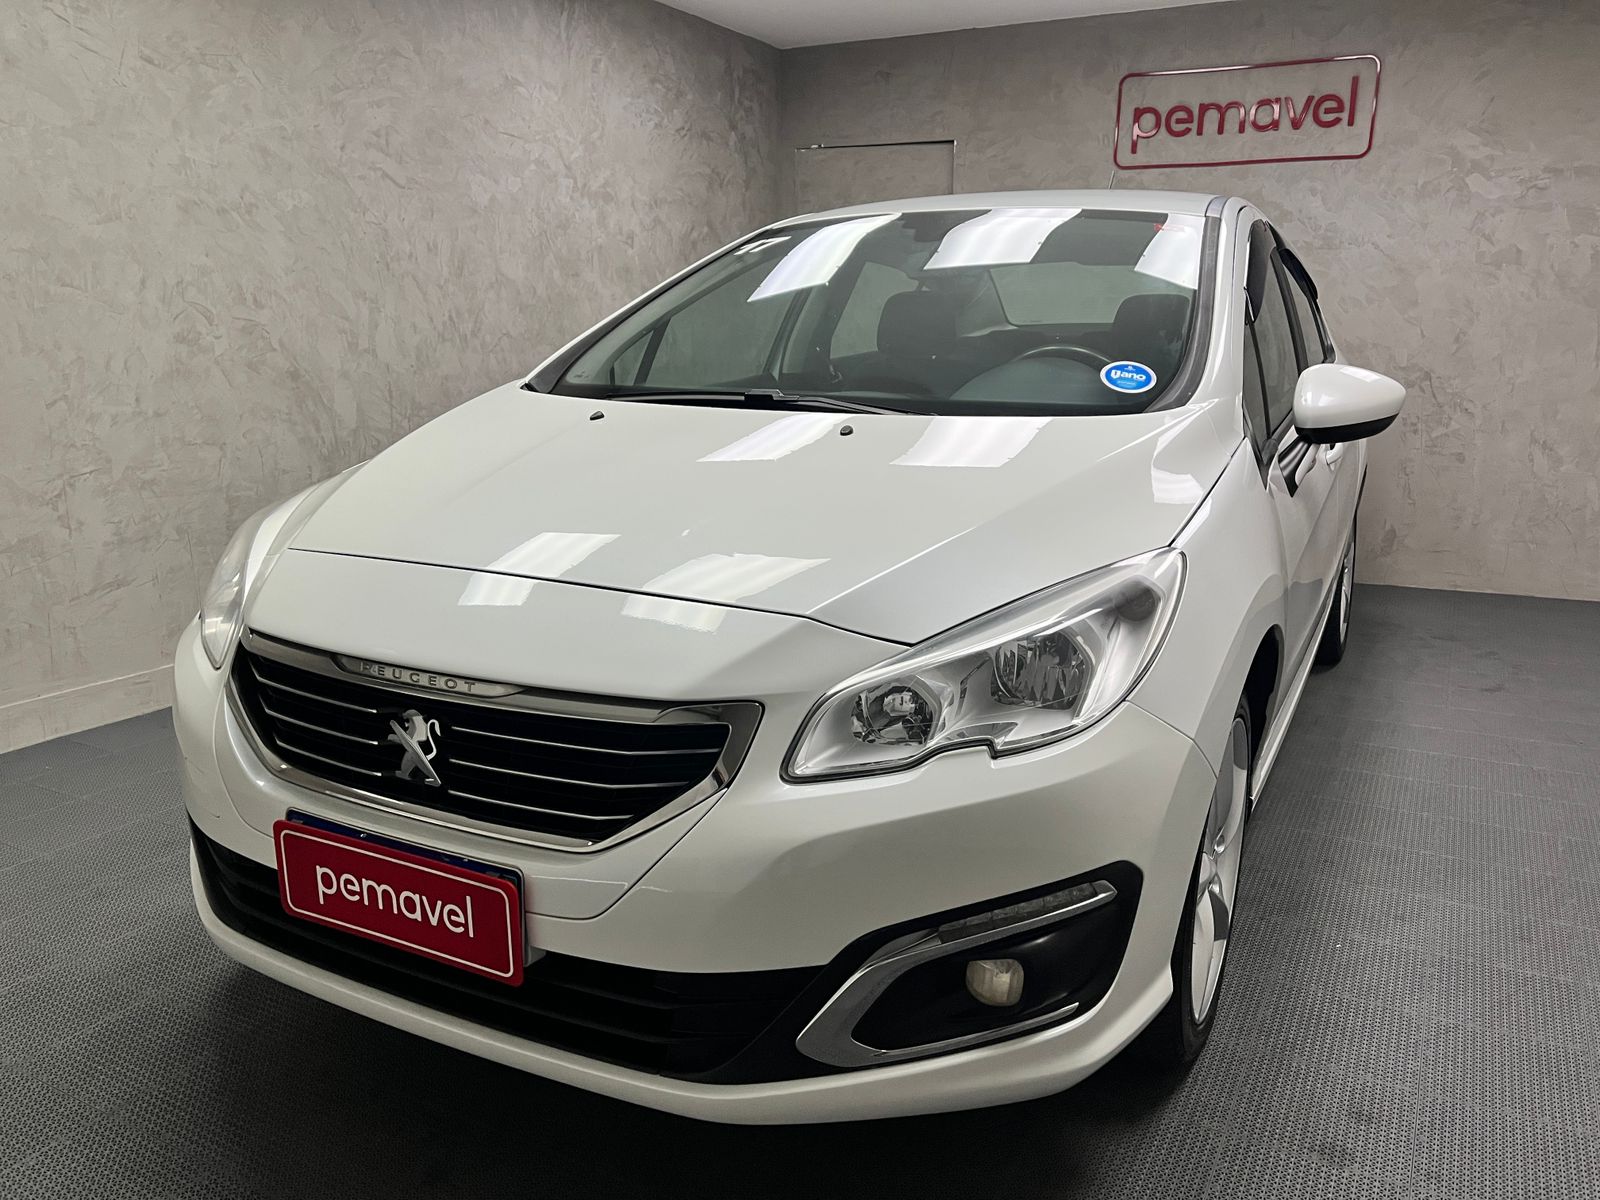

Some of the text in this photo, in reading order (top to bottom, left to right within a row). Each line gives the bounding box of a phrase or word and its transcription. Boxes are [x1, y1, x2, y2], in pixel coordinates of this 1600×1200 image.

[1131, 75, 1360, 155] pemavel
[359, 660, 476, 692] PEUGEOT
[315, 864, 474, 938] pemavel
